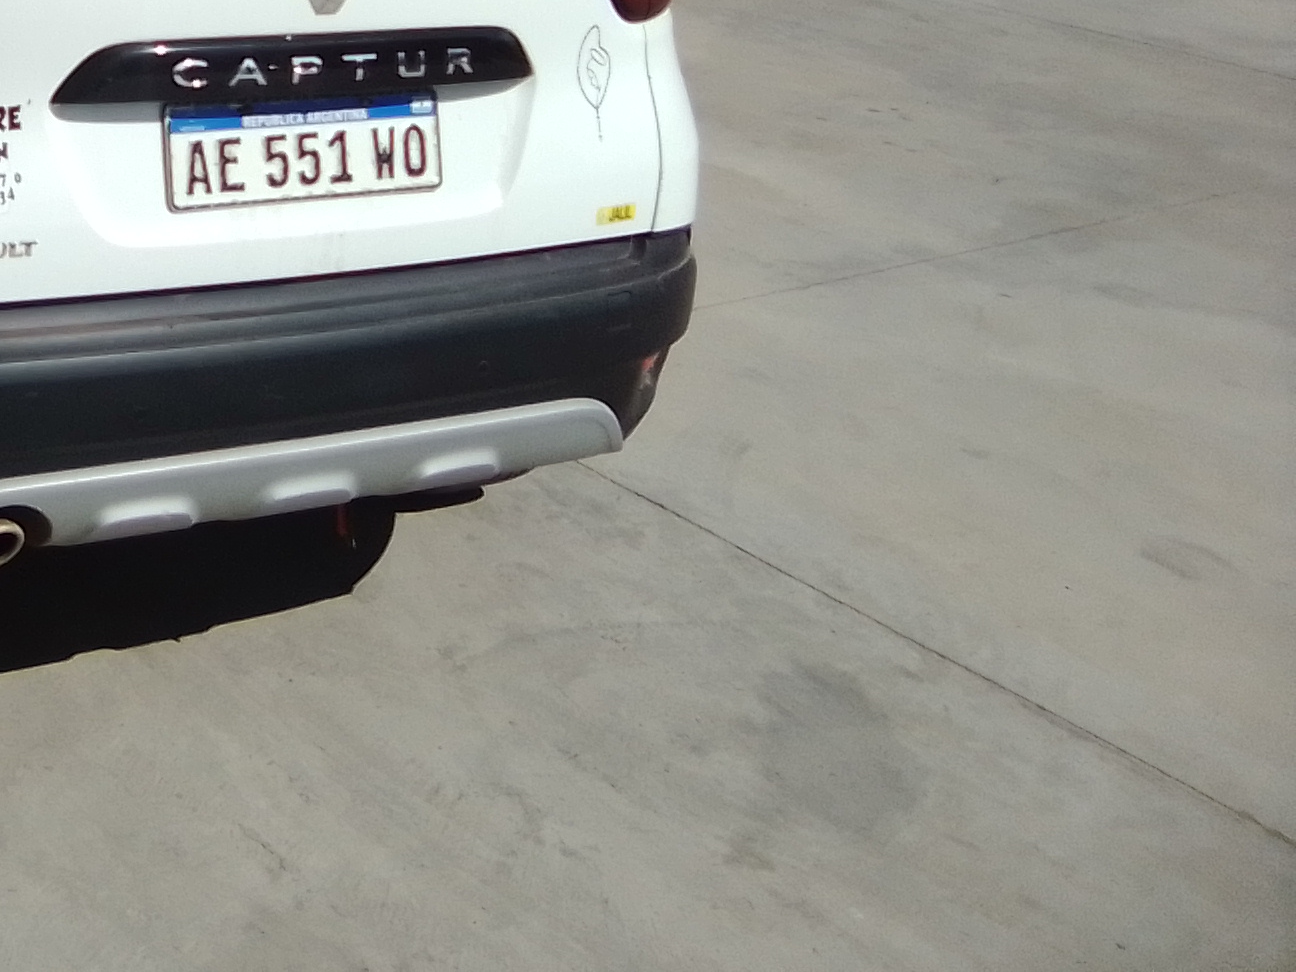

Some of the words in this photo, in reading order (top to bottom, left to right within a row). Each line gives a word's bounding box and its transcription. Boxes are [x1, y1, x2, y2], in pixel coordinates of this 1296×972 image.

[172, 47, 475, 88] CAPTUR
[306, 107, 369, 123] ARGENTINA
[186, 136, 246, 195] AE
[264, 129, 354, 188] 551
